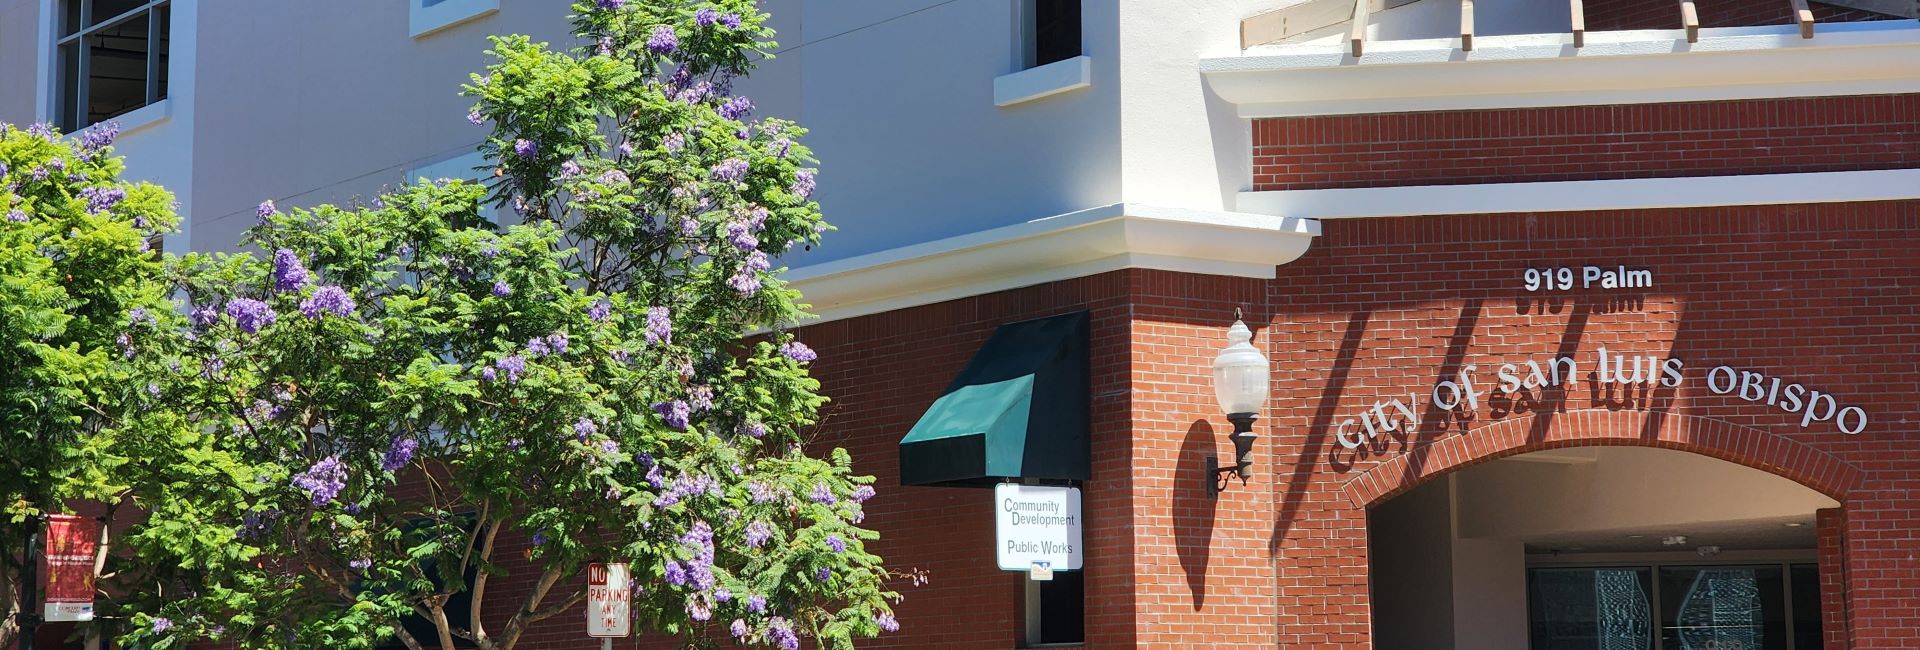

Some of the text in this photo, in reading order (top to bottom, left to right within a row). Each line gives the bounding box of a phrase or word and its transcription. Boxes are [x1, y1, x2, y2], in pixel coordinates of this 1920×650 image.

[1524, 265, 1653, 291] 919 Palm
[1004, 498, 1060, 515] Community
[1012, 512, 1075, 528] Development
[1007, 540, 1073, 555] Public Works
[591, 566, 606, 583] NO
[590, 588, 628, 602] PARKING
[601, 605, 616, 615] ANY
[601, 617, 617, 628] TIME
